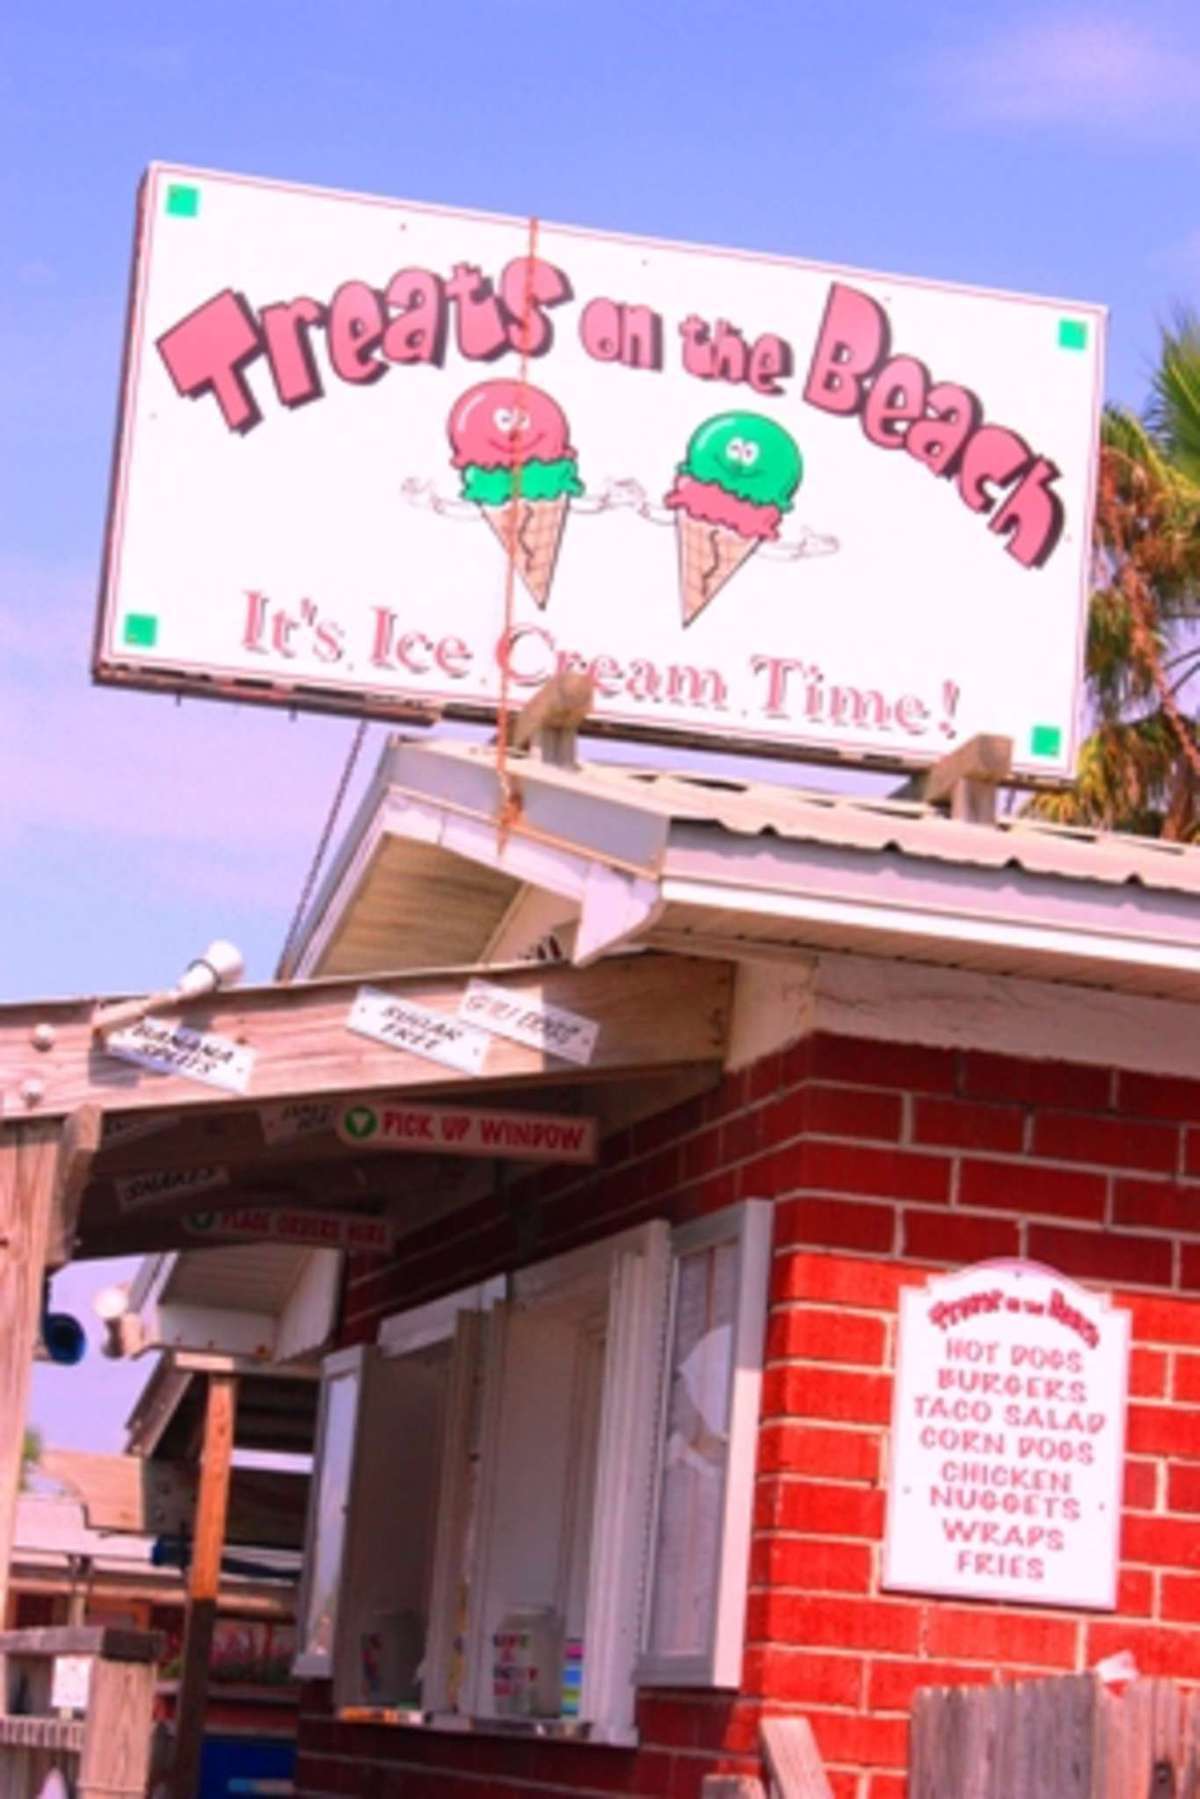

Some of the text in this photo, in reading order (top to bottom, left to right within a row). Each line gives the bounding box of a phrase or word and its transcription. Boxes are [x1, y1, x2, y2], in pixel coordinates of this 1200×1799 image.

[156, 256, 1065, 570] Treats on the Beach
[241, 589, 960, 740] It's Ice Cream Time!
[382, 1111, 586, 1152] PICK UP WINDOW
[946, 1337, 1083, 1374] HOT DOGS
[937, 1368, 1088, 1404] BURGERS
[914, 1396, 1107, 1435] TACO SALAD
[919, 1426, 1095, 1465] CORN DOGS
[941, 1461, 1073, 1494] CHICKEN
[930, 1485, 1081, 1521] NUGGETS
[941, 1518, 1065, 1551] WRAPS
[956, 1549, 1046, 1580] FRIES
